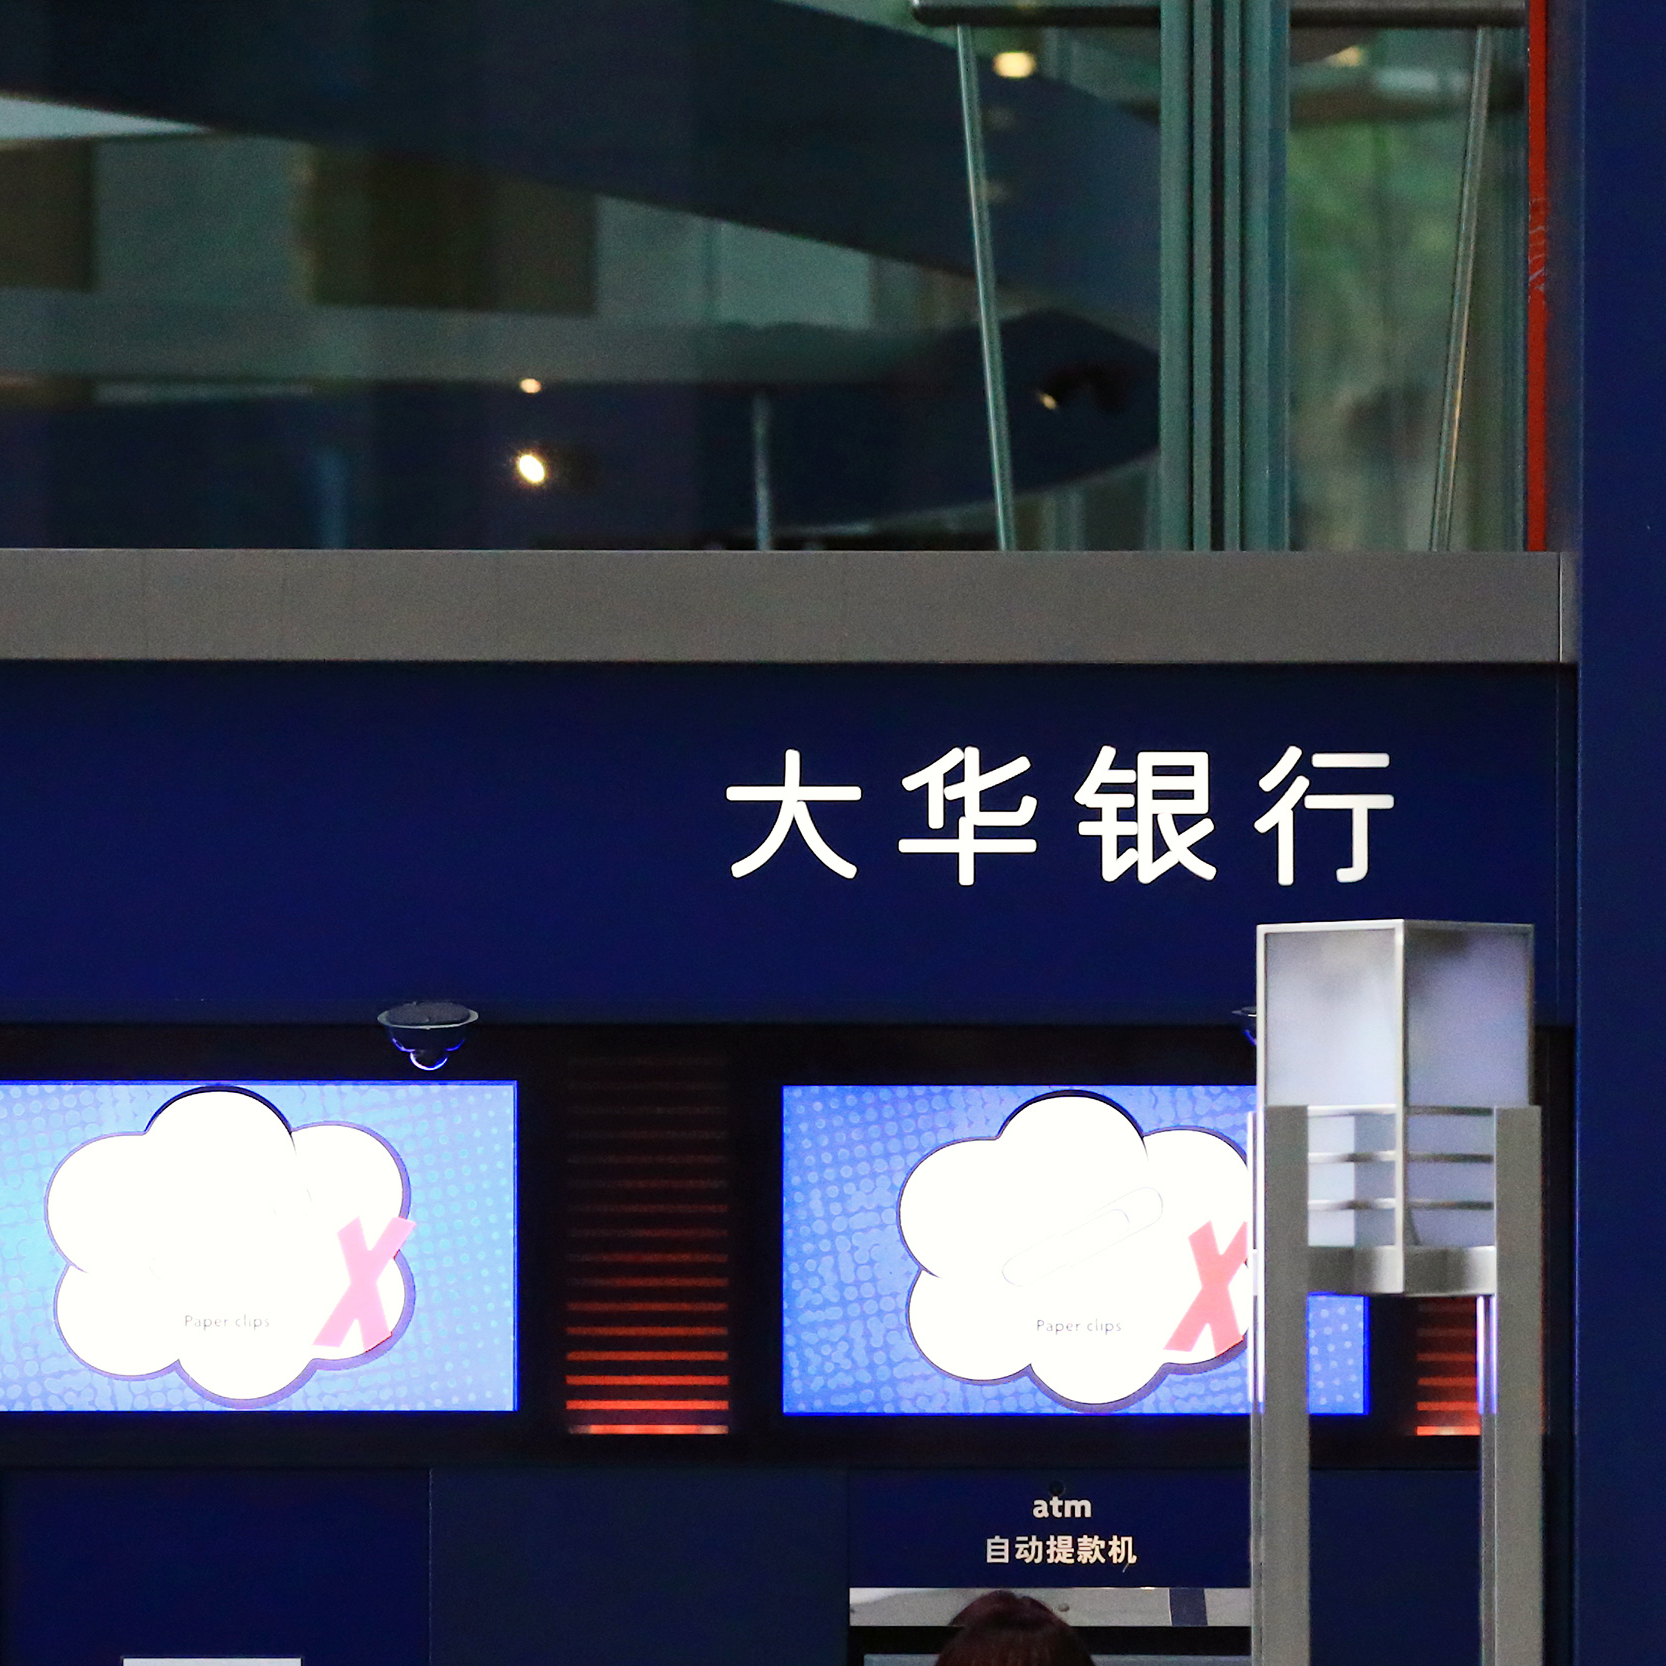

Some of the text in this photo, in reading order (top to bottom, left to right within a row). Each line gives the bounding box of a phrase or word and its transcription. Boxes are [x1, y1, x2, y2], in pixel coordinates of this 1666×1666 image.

[725, 745, 1395, 886] 大华银行
[184, 1313, 270, 1331] Paper clips
[1036, 1318, 1122, 1336] Paper clips
[1032, 1496, 1093, 1519] atm
[986, 1535, 1138, 1564] 自动提款机
